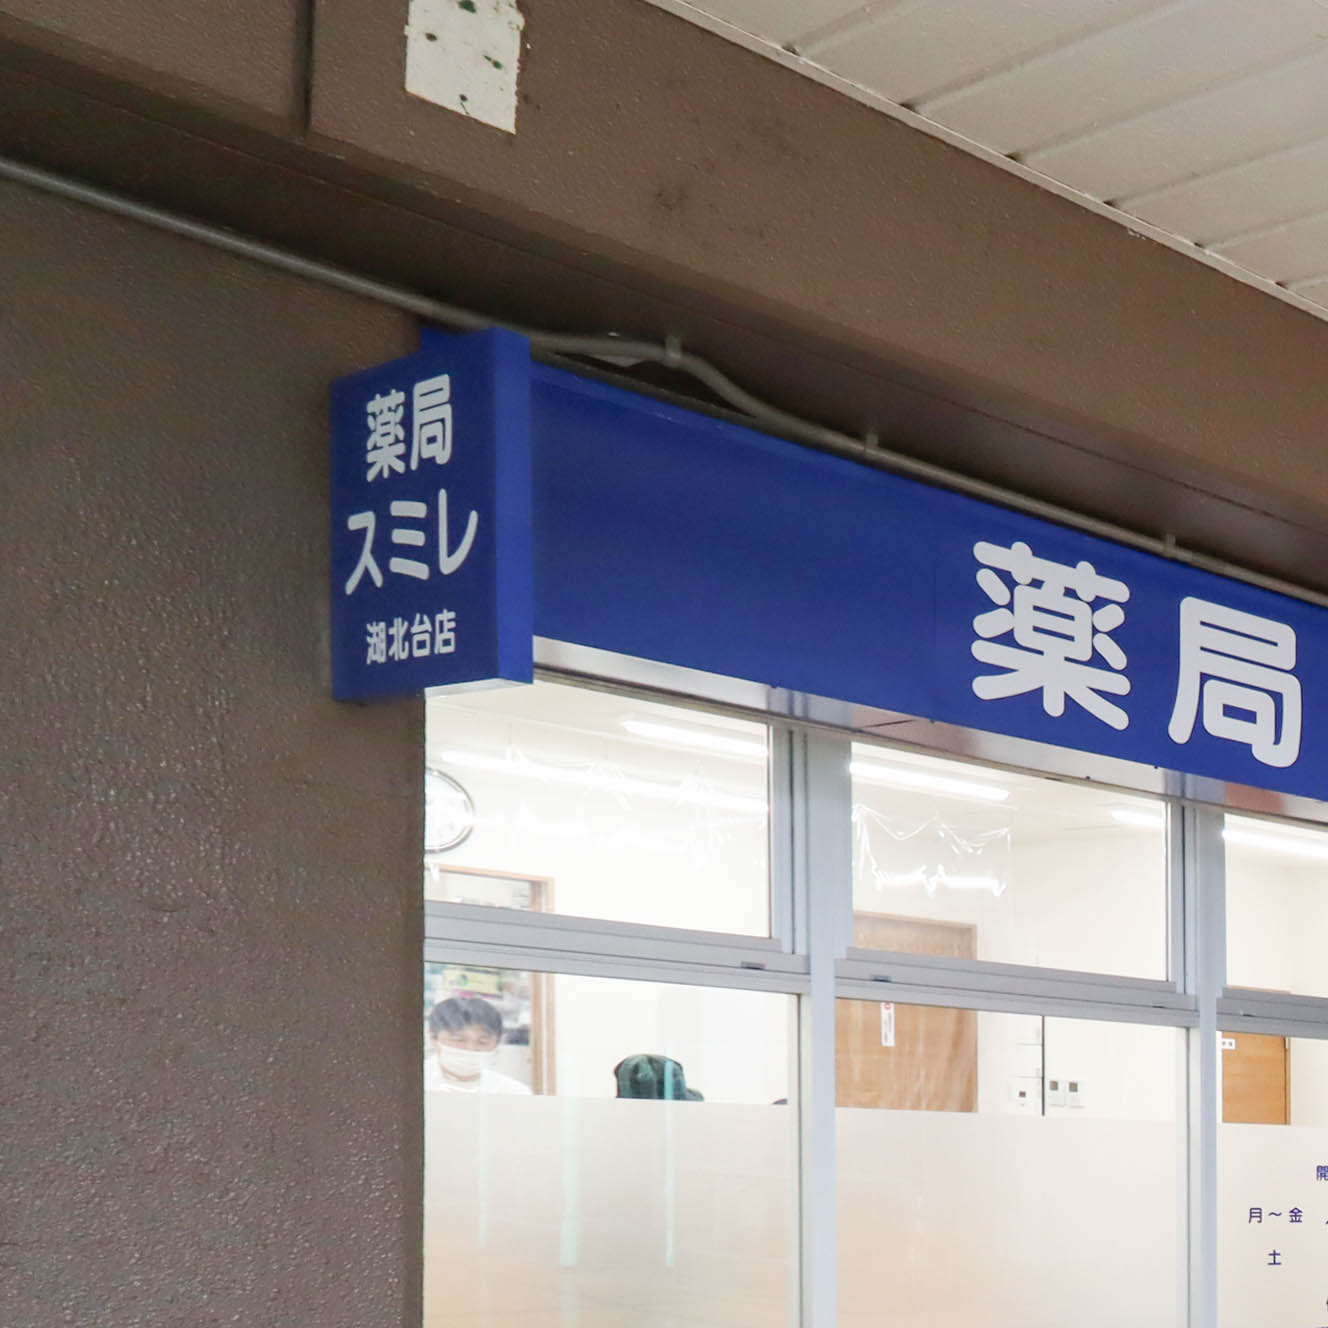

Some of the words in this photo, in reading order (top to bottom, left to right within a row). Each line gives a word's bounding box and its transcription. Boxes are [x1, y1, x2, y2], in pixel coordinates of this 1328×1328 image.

[365, 373, 453, 483] 薬局
[344, 488, 479, 595] スミレ
[365, 608, 456, 666] 湖北台店
[1267, 1250, 1282, 1265] 土
